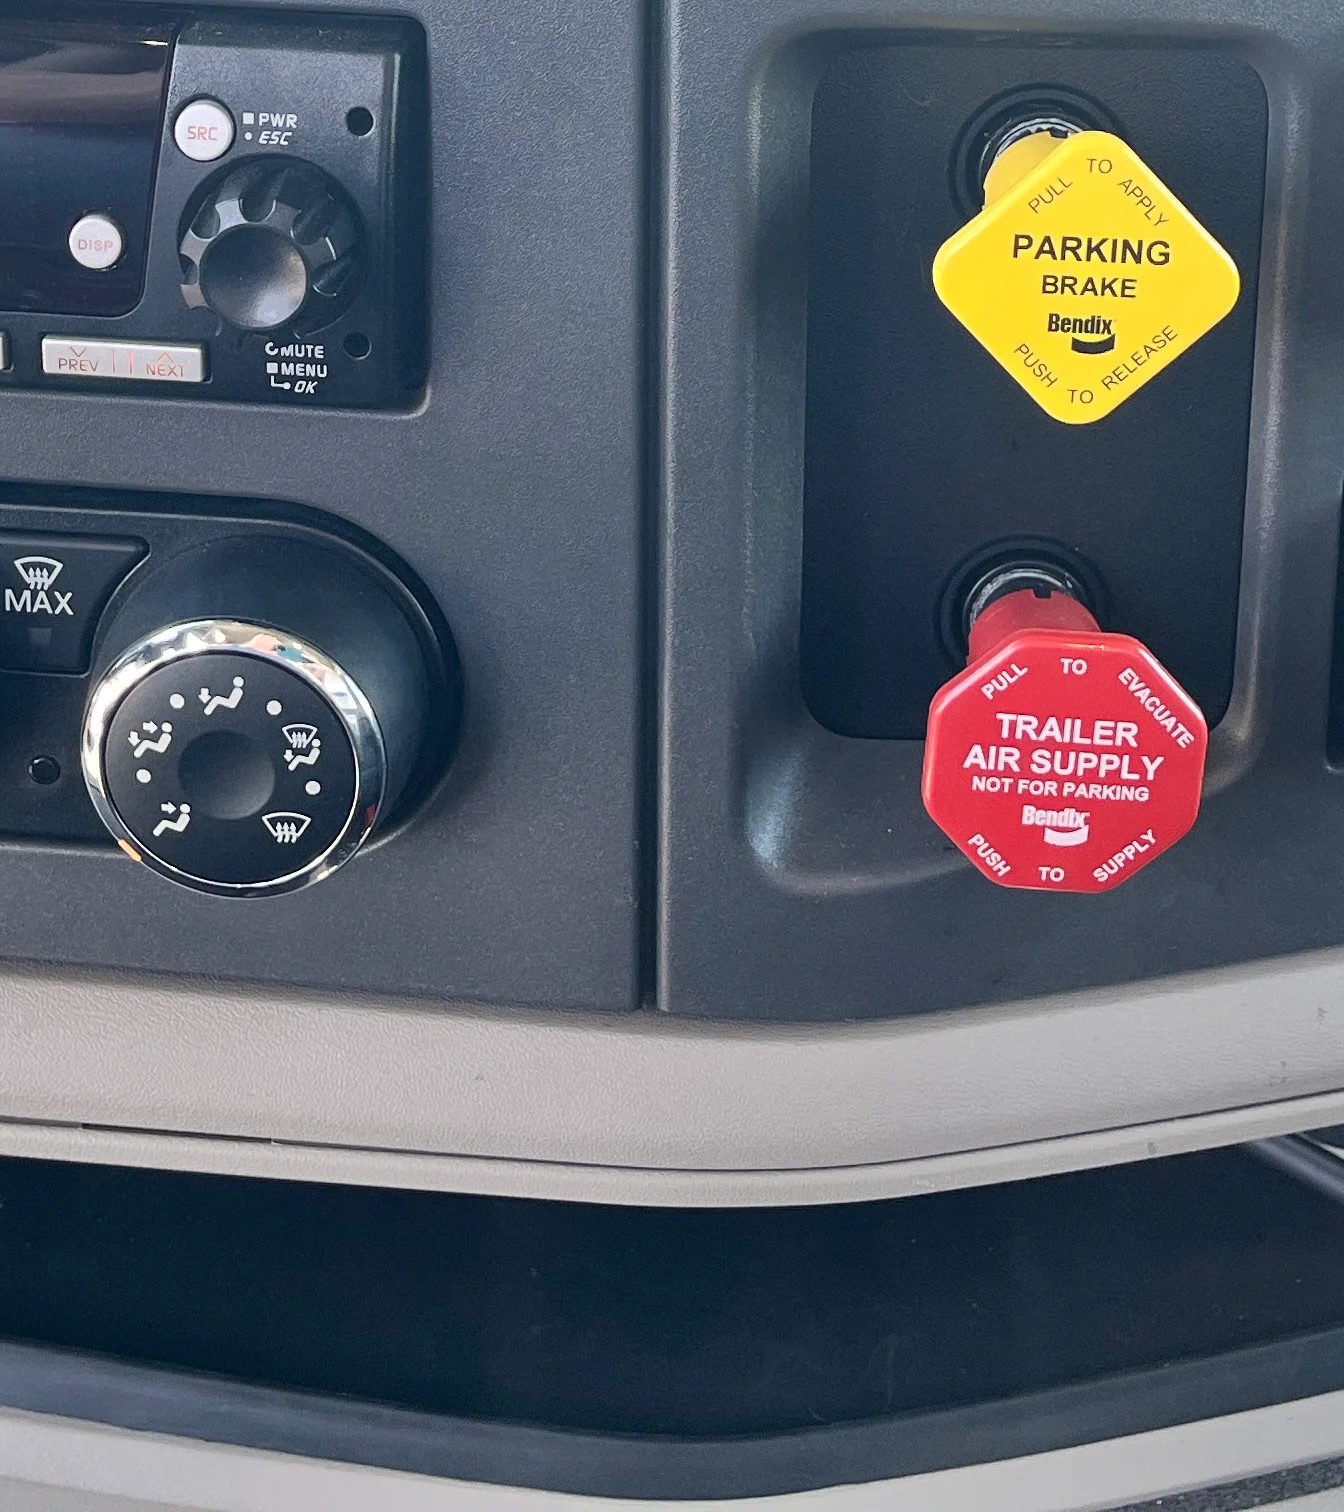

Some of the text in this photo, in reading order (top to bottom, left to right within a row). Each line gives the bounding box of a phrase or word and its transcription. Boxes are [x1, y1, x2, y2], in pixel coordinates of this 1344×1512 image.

[258, 112, 298, 128] PWR
[187, 125, 218, 141] SRC
[258, 131, 292, 146] ESC
[1028, 158, 1170, 228] PULL TO APPLY
[78, 239, 113, 252] DISP
[1012, 233, 1171, 266] PARKING
[1041, 274, 1137, 298] BRAKE
[1048, 312, 1113, 335] Bendix
[280, 344, 324, 359] MUTE
[58, 357, 99, 372] PREV
[146, 363, 184, 378] NEXT
[281, 362, 327, 378] MENU
[1013, 324, 1179, 404] PUSH TO RELEASE
[294, 380, 318, 394] OK
[4, 588, 74, 616] MAX
[981, 657, 1195, 749] PULL TO EVACUATE
[995, 712, 1139, 748] TRAILER
[962, 744, 1165, 781] AIR SUPPLY
[971, 775, 1150, 802] NOT FOR PARKING
[1021, 804, 1087, 828] Bendix
[967, 829, 1157, 883] PUSH TO SUPPLY
